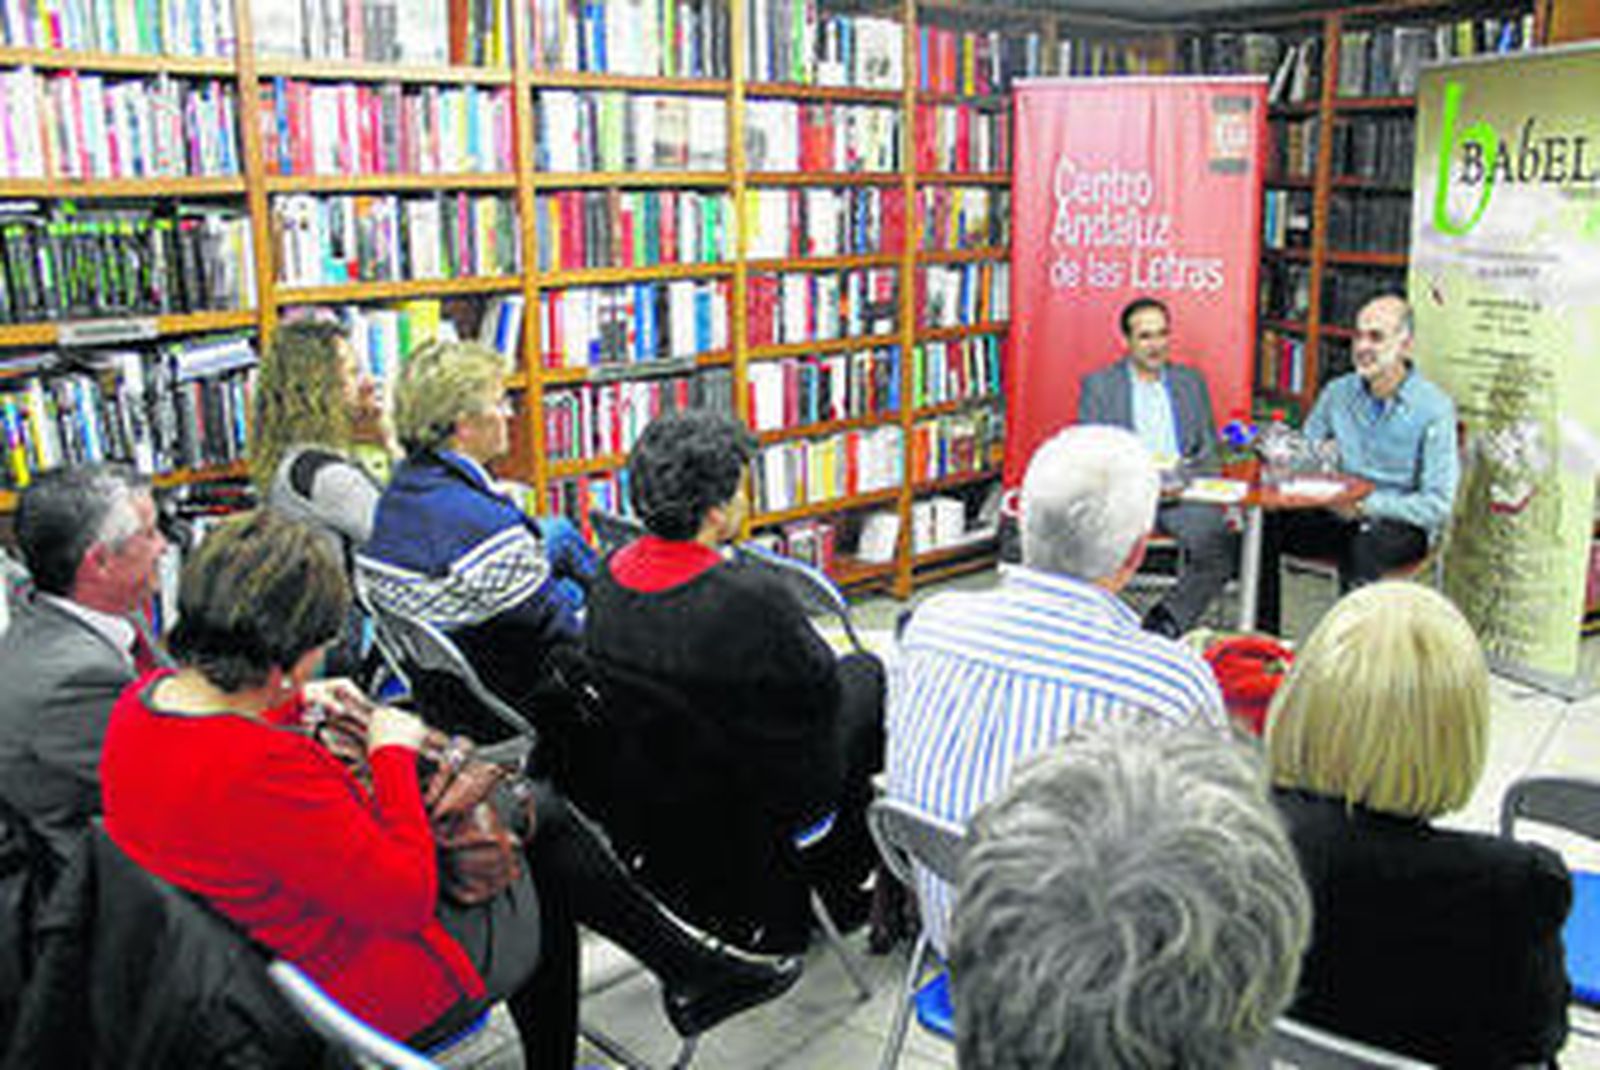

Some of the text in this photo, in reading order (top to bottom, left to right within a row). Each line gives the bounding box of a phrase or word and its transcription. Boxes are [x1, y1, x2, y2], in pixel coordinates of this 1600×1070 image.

[1054, 154, 1153, 206] Centro
[1051, 197, 1172, 247] Andaluz
[1052, 250, 1224, 290] de las Letras
